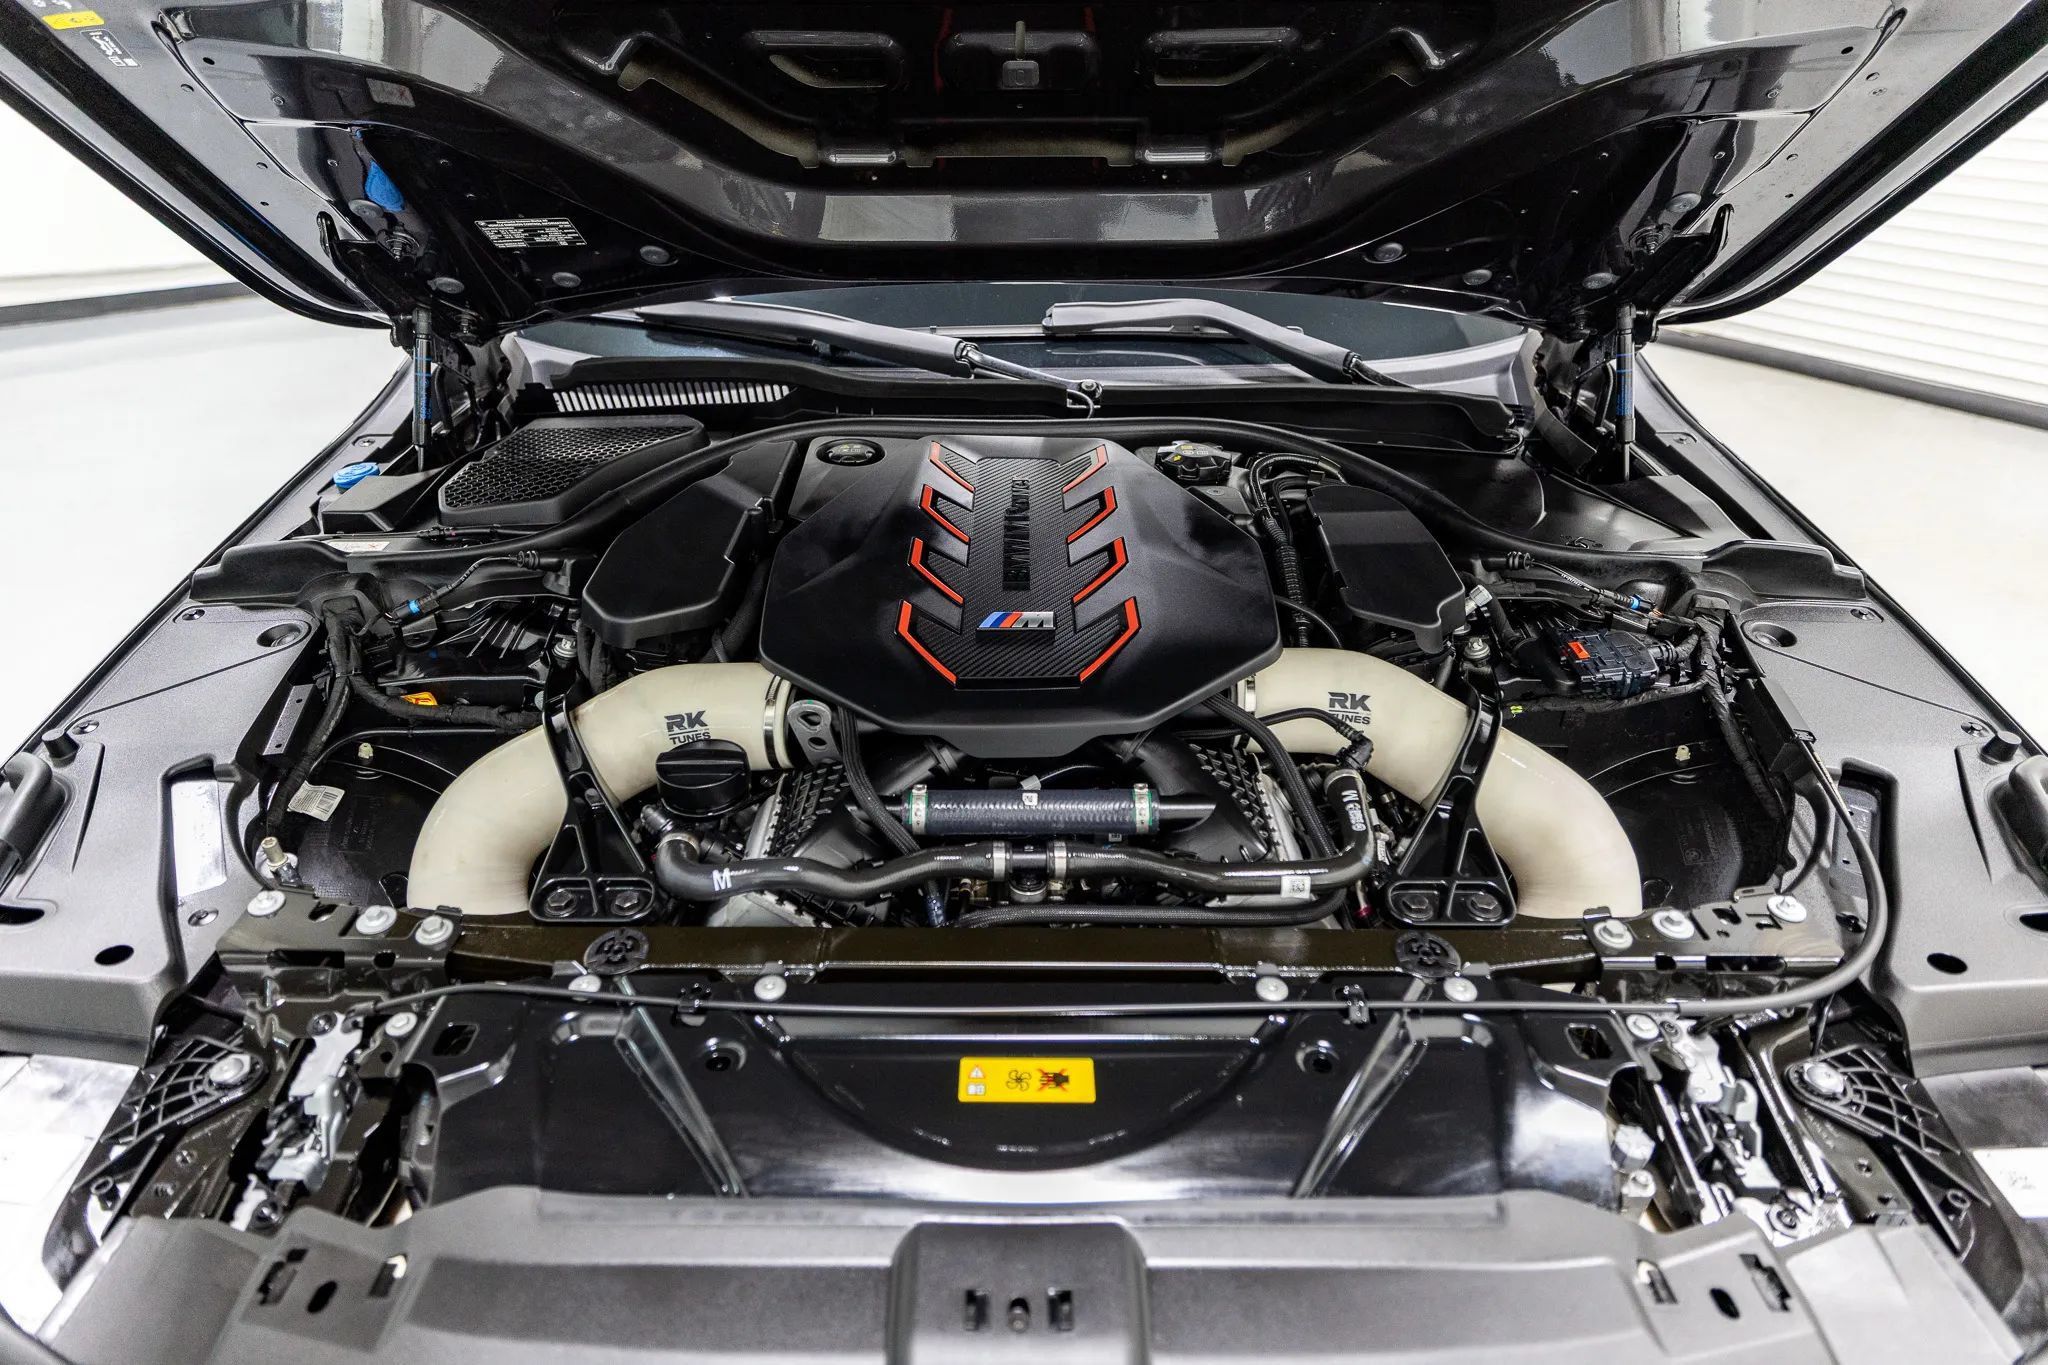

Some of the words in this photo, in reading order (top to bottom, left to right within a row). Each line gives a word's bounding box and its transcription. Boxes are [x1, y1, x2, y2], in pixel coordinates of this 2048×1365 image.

[1328, 691, 1371, 712] RK
[664, 710, 709, 732] RK
[669, 731, 711, 745] TUNES
[712, 867, 732, 891] M
